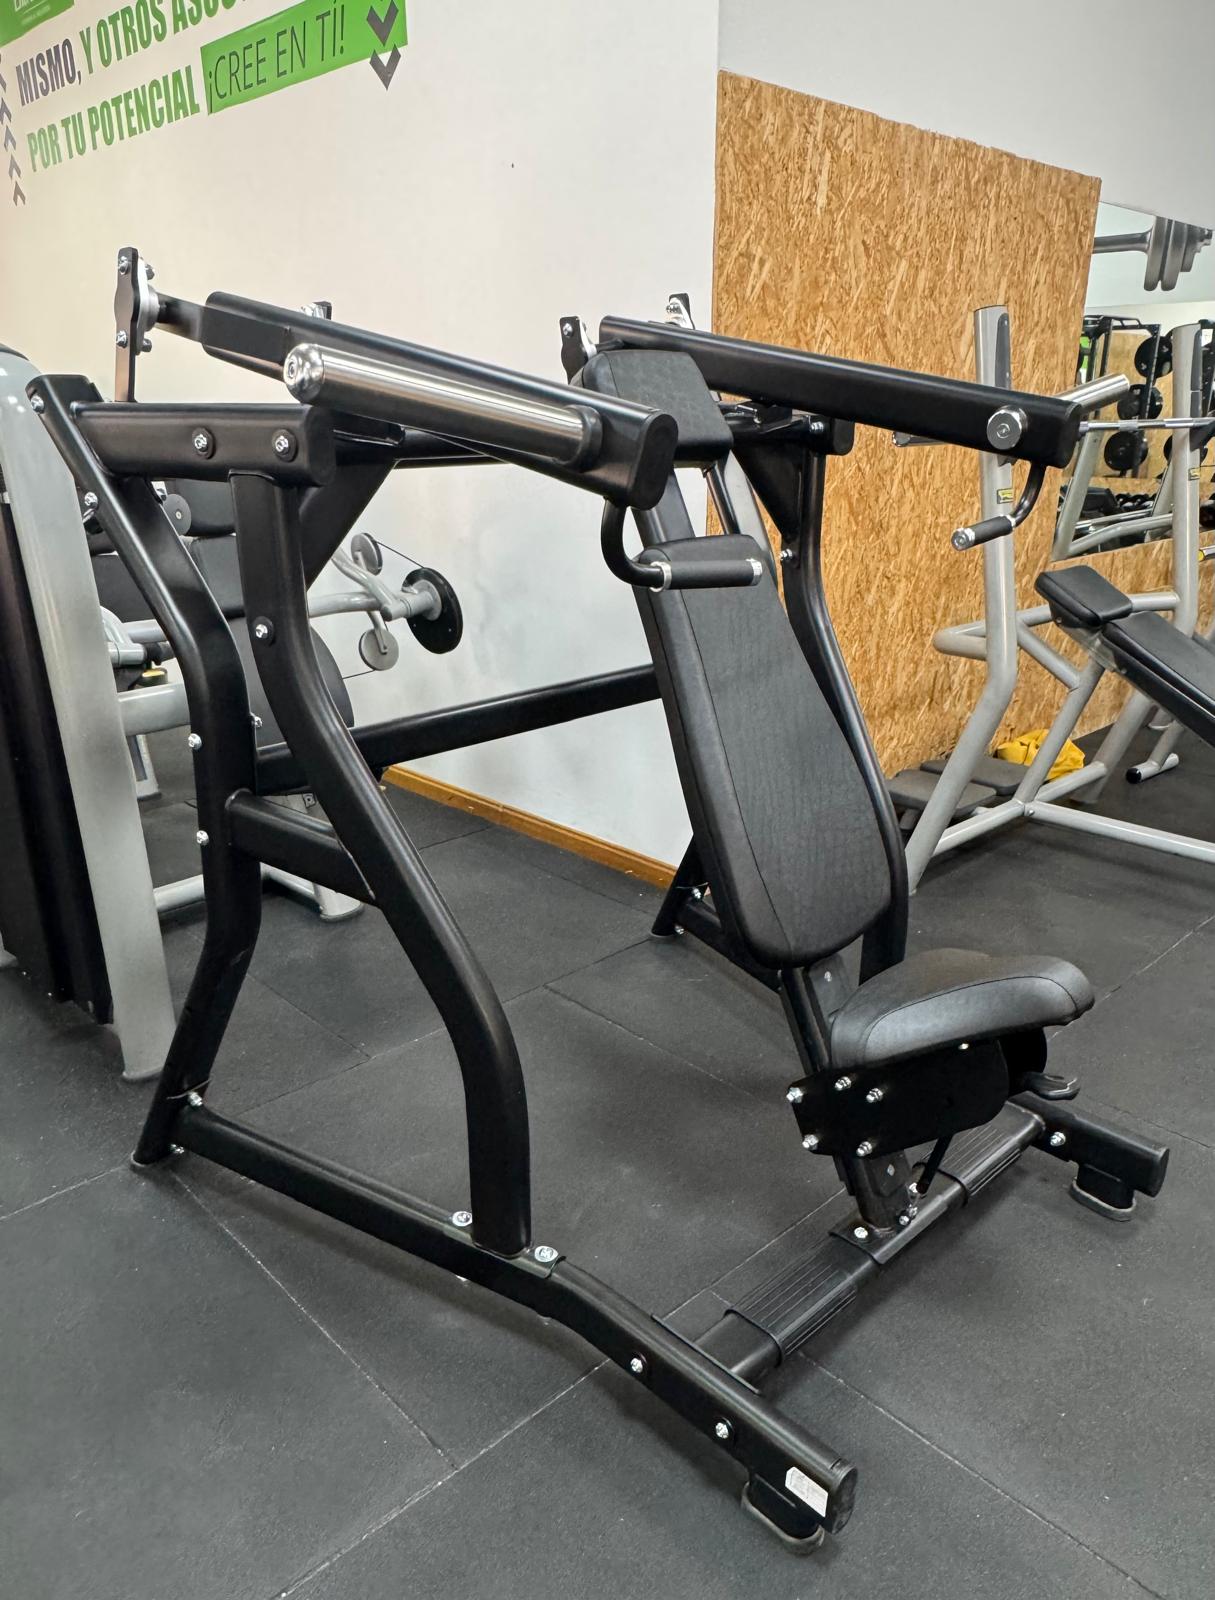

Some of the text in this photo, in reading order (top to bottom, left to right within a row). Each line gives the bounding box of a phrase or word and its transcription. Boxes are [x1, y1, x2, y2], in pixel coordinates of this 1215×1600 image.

[16, 38, 81, 106] MISMO,
[79, 27, 93, 74] Y
[97, 0, 167, 67] OTROS
[26, 123, 62, 172] POR
[61, 112, 86, 159] TU
[87, 65, 200, 150] POTENCIAL
[208, 38, 267, 114] ¡CREE
[276, 20, 306, 78] EN
[316, 0, 345, 61] TÍ!
